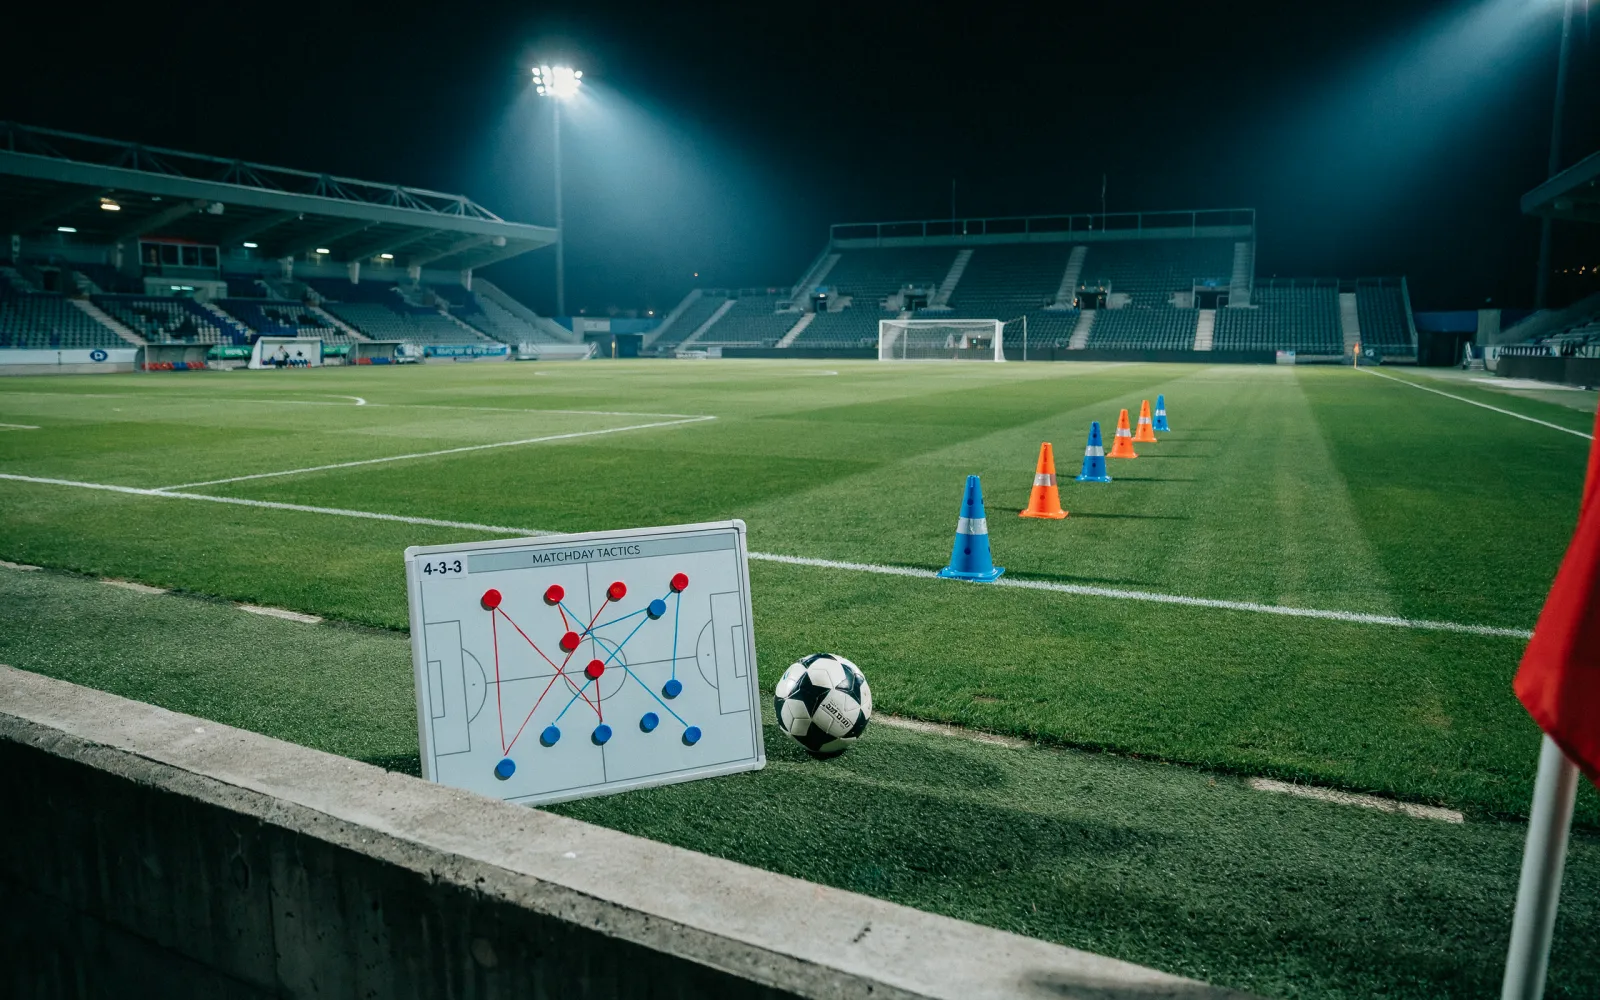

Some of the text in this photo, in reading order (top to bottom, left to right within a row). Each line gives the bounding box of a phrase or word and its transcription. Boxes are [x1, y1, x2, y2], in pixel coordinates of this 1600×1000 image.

[532, 545, 641, 563] MATCHDAY TACTICS
[423, 560, 462, 575] 4-3-3
